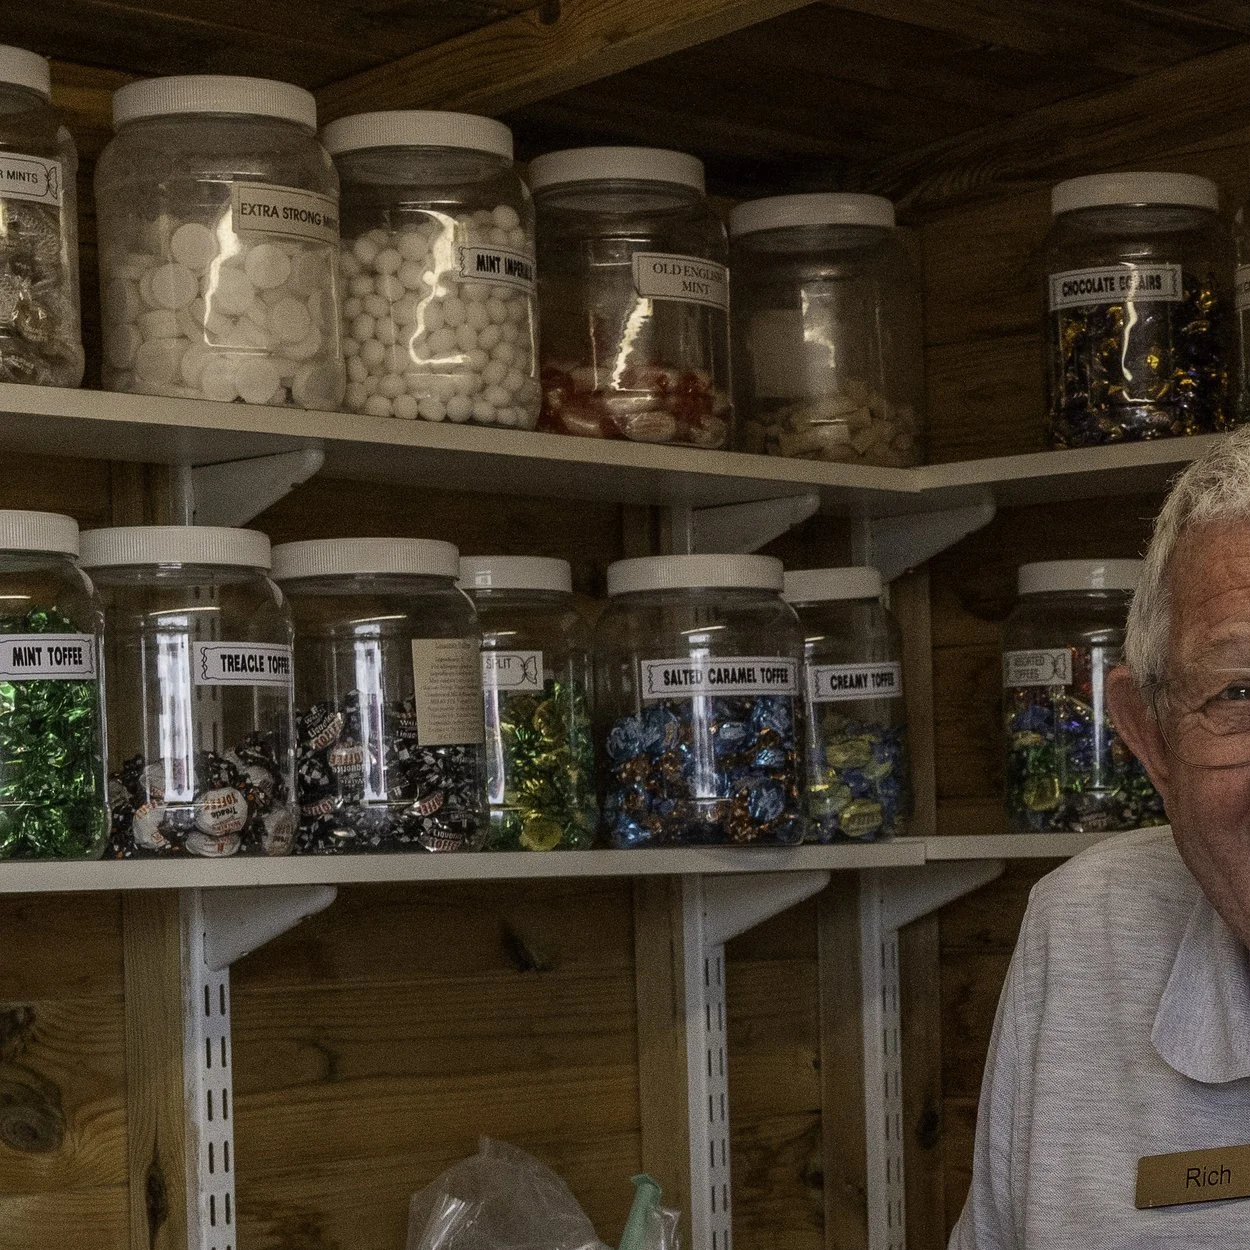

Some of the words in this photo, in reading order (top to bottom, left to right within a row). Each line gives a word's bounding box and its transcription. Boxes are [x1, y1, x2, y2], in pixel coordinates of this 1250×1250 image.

[7, 170, 38, 184] MINTS
[240, 203, 280, 218] EXTRA
[282, 207, 321, 225] STRONG
[476, 254, 501, 274] MINT
[652, 262, 682, 276] OLD
[683, 264, 724, 283] ENGLISH
[682, 281, 711, 295] MINT
[1062, 277, 1115, 297] CHOCOLATE
[1119, 274, 1162, 291] ECAIRS
[12, 646, 42, 667] MINT
[47, 647, 83, 666] TOFFEE
[220, 654, 265, 673] TREACLE
[485, 658, 512, 670] SPLIT
[663, 669, 702, 686] SALTED
[708, 667, 757, 685] CARAMEL
[760, 667, 788, 684] TOFFEE
[830, 673, 868, 691] CREAMY
[871, 672, 894, 687] TOFFEE
[1185, 1166, 1231, 1189] Rich
